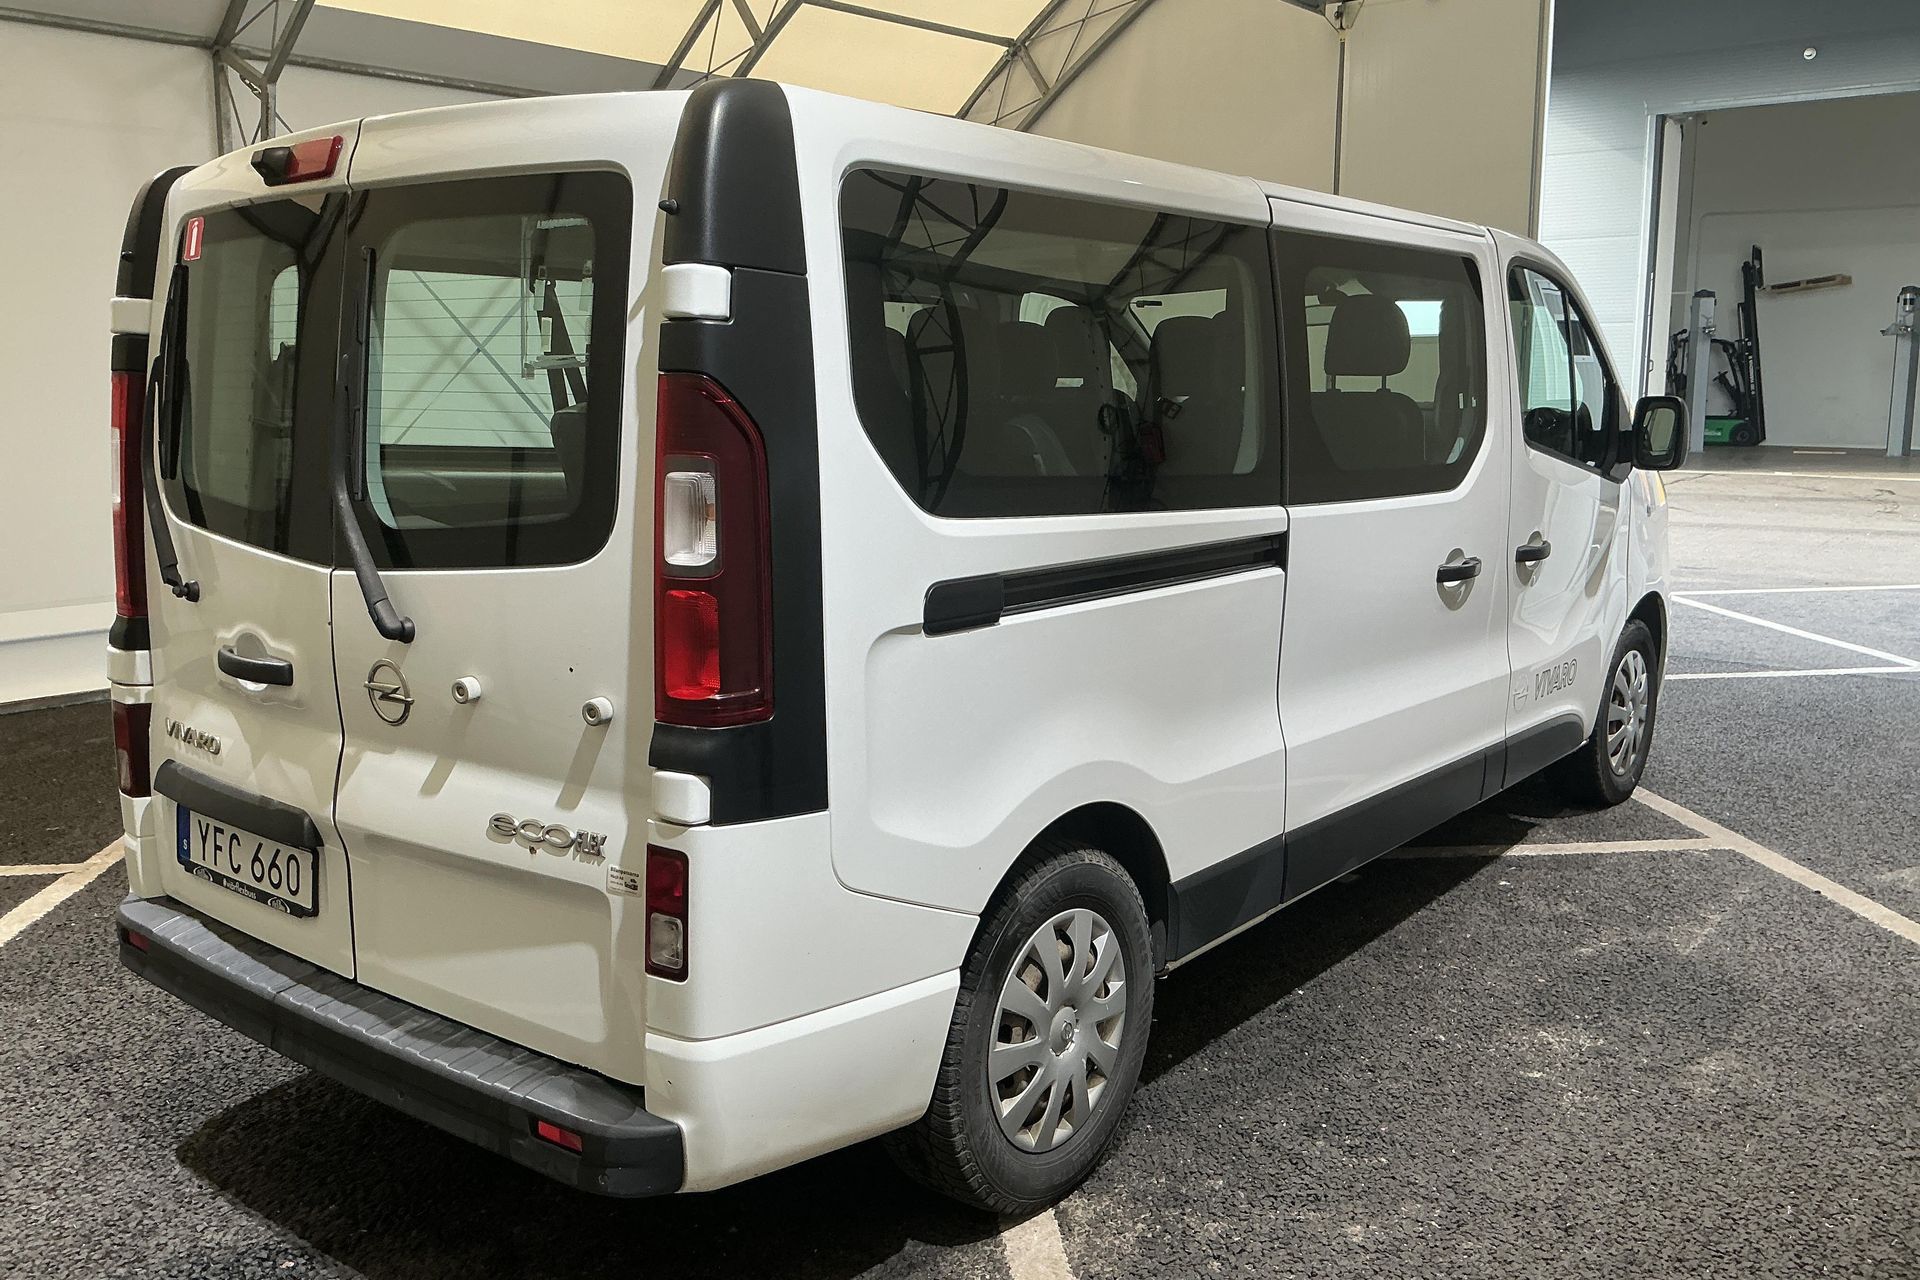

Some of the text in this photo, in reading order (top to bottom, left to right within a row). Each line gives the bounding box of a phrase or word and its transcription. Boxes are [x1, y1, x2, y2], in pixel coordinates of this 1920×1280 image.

[1535, 658, 1577, 701] VIVARO
[165, 717, 222, 755] VIVARO
[183, 839, 188, 850] S
[198, 819, 300, 896] YFC 660
